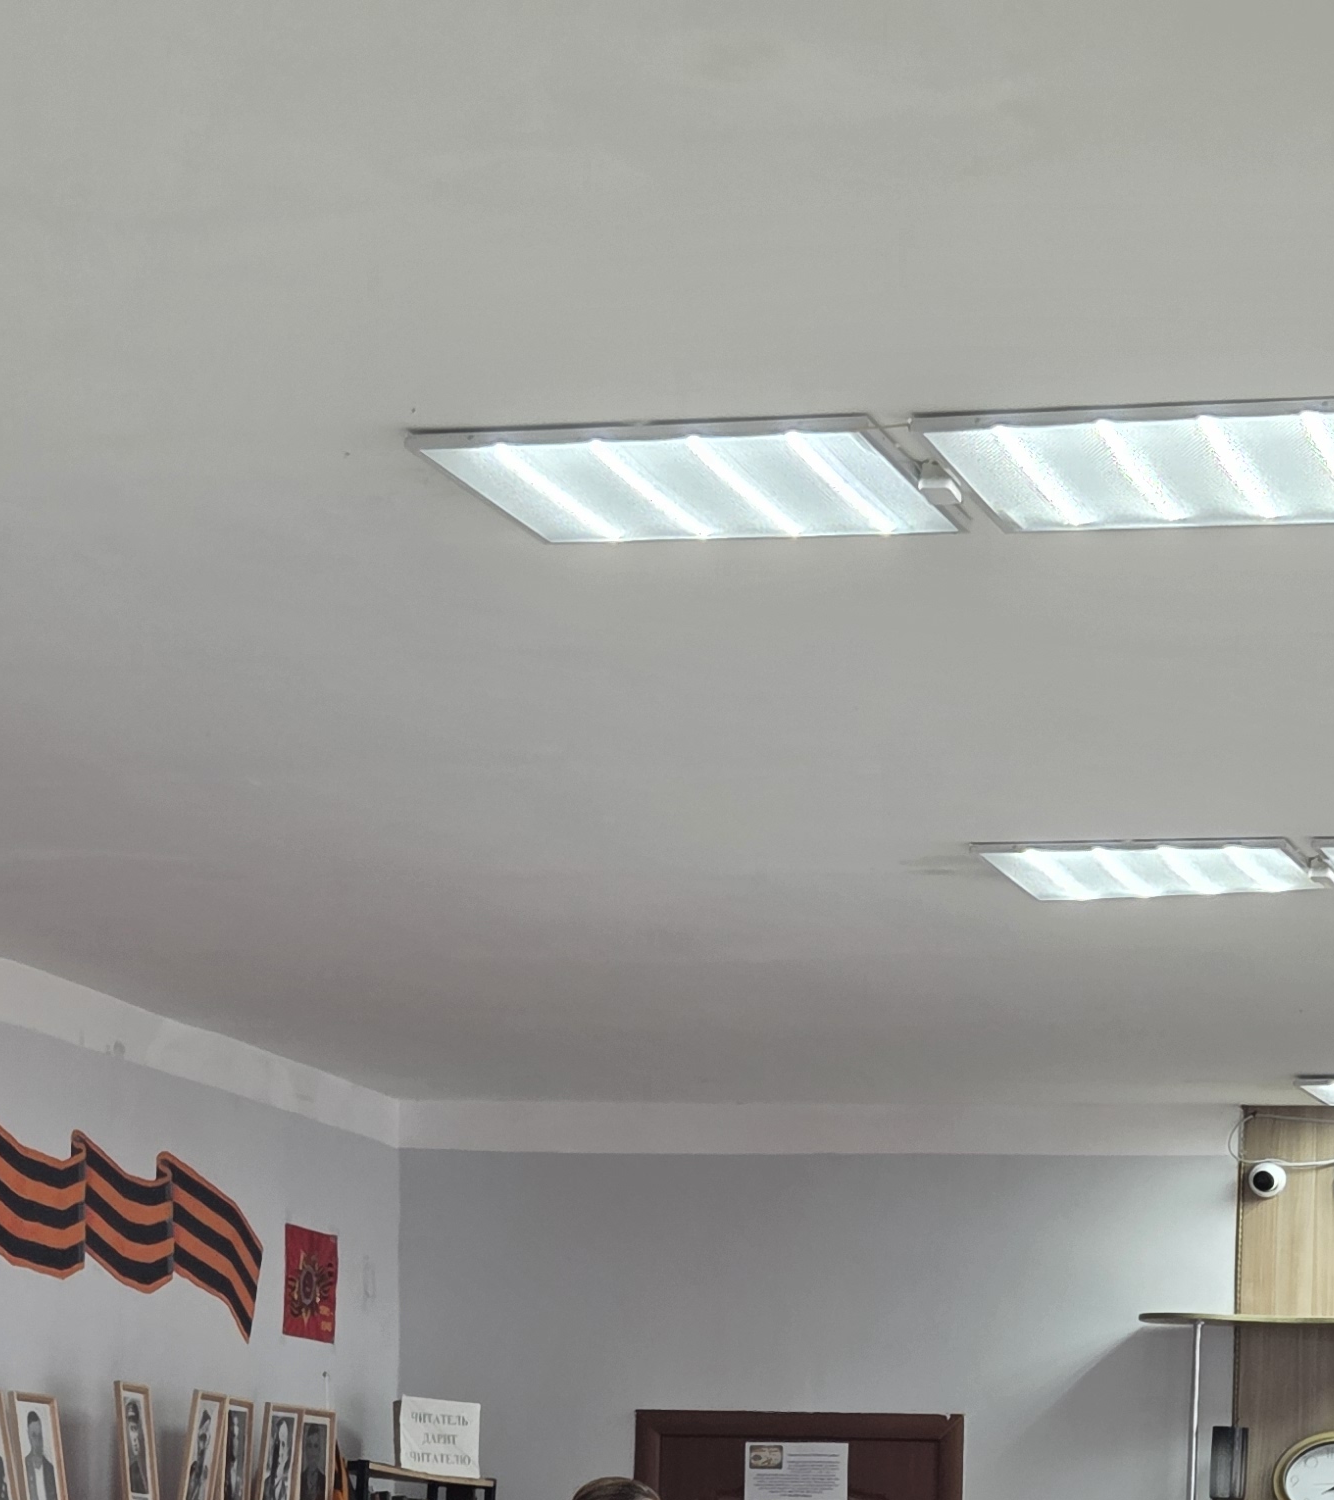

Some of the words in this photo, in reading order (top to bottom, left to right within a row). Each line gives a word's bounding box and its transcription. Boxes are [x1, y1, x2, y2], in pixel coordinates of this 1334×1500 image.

[411, 1411, 468, 1426] ЧИТАТЕЛЬ
[422, 1432, 458, 1445] ДАРИТ
[409, 1451, 471, 1466] ЧИТАТЕЛЮ
